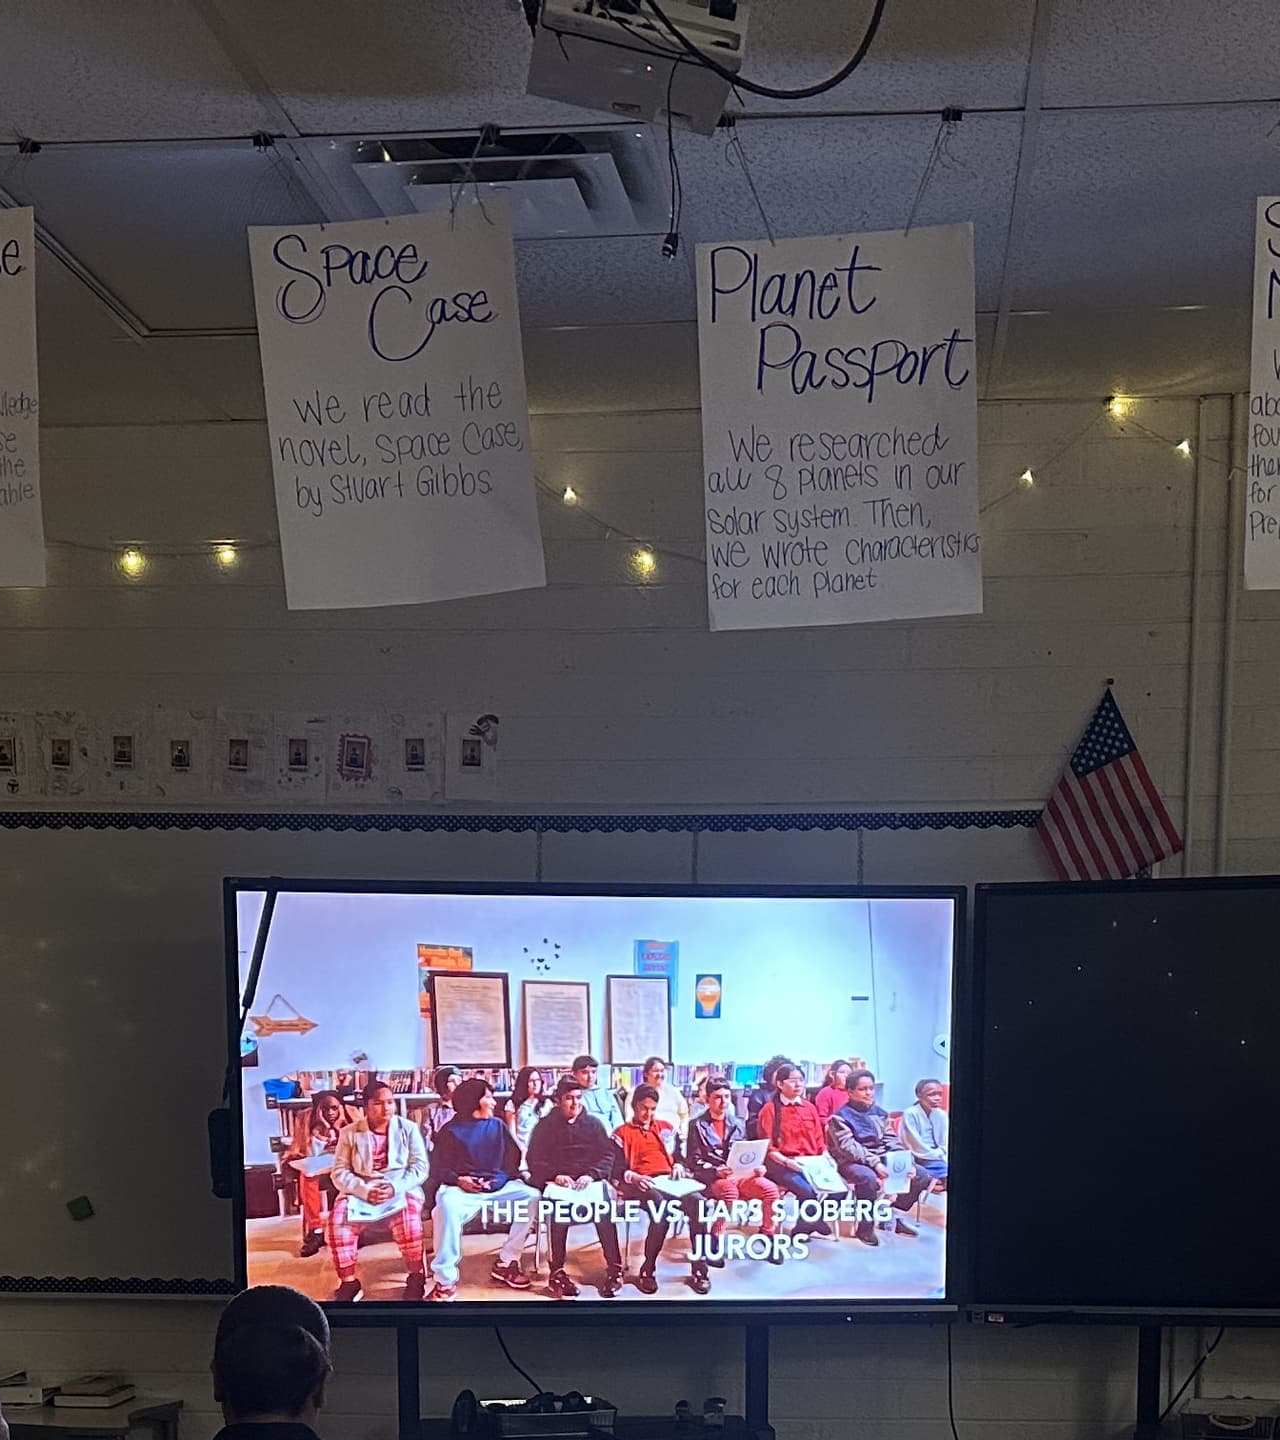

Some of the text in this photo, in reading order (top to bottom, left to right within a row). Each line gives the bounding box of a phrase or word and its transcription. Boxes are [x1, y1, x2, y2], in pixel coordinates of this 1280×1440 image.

[273, 234, 428, 323] Space
[710, 245, 882, 323] Planet
[369, 285, 499, 361] Case
[757, 320, 973, 404] Passport
[362, 382, 430, 422] read
[454, 376, 502, 412] the
[278, 434, 367, 466] novel,
[728, 422, 950, 462] We researched
[296, 476, 322, 517] by
[330, 470, 404, 504] Stuart
[708, 464, 787, 500] all 8
[712, 570, 800, 600] for each
[480, 1200, 892, 1223] THE PEOPLE VS. LARS SJOBERG
[688, 1234, 810, 1260] JURORS
